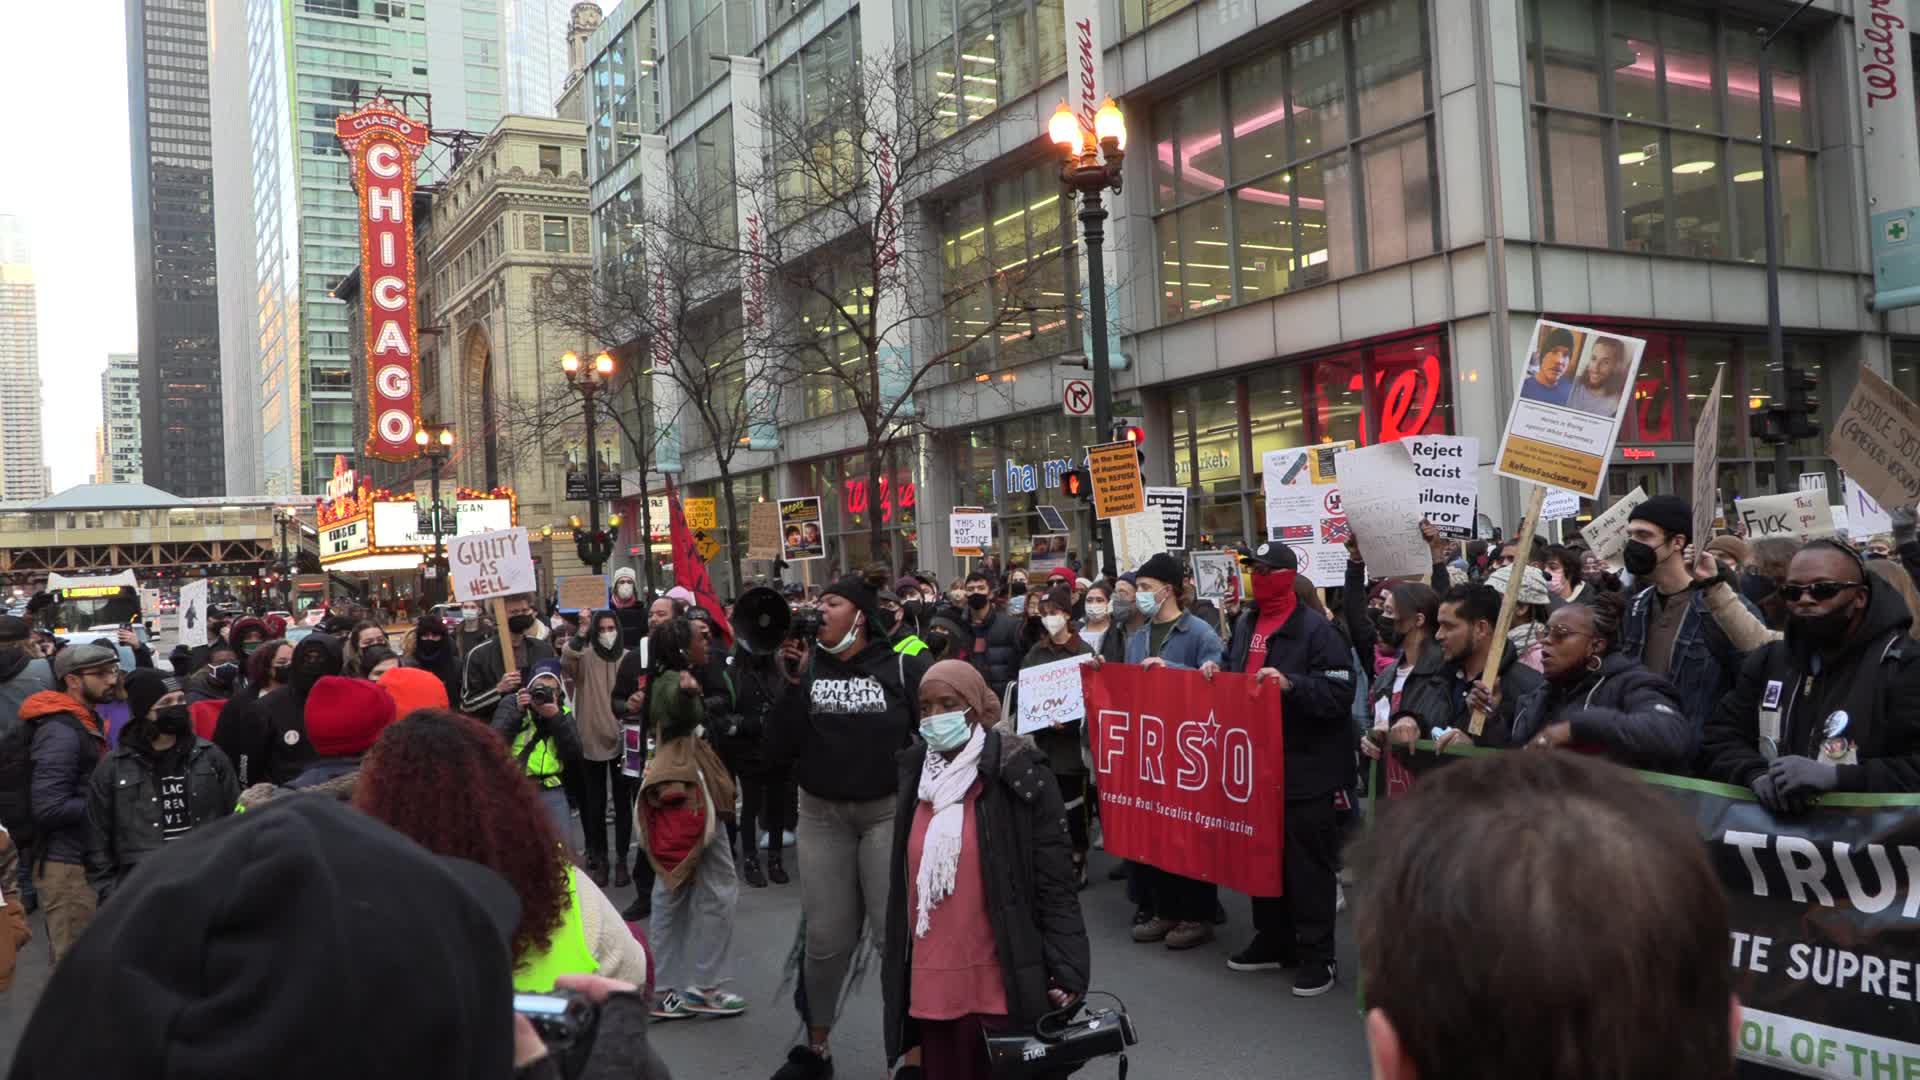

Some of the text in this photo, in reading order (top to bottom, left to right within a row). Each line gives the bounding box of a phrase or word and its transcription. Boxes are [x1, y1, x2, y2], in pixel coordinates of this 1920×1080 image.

[353, 114, 397, 129] CHASE
[366, 143, 413, 444] CHICAGO
[1413, 442, 1462, 459] Reject
[1414, 463, 1461, 479] Racist
[1508, 460, 1588, 489] RefuseFascism.org
[1109, 482, 1134, 493] Accept
[1109, 493, 1135, 501] Fascist
[1795, 496, 1813, 509] This
[456, 503, 484, 512] EGAN
[1105, 503, 1137, 513] America!
[955, 519, 986, 528] THIS IS
[1424, 511, 1461, 523] rror
[1800, 515, 1815, 528] you
[954, 528, 971, 536] NOT
[955, 535, 988, 544] JUSTICE
[457, 534, 518, 566] GUILTY
[479, 561, 498, 577] AS
[469, 576, 511, 596] HELL
[1031, 694, 1068, 715] NOW
[1098, 709, 1253, 803] FRSO
[1156, 802, 1193, 821] Socialist
[1729, 931, 1920, 1002] TE SUPRE
[1740, 1020, 1782, 1057] OL
[1790, 1032, 1838, 1068] OF
